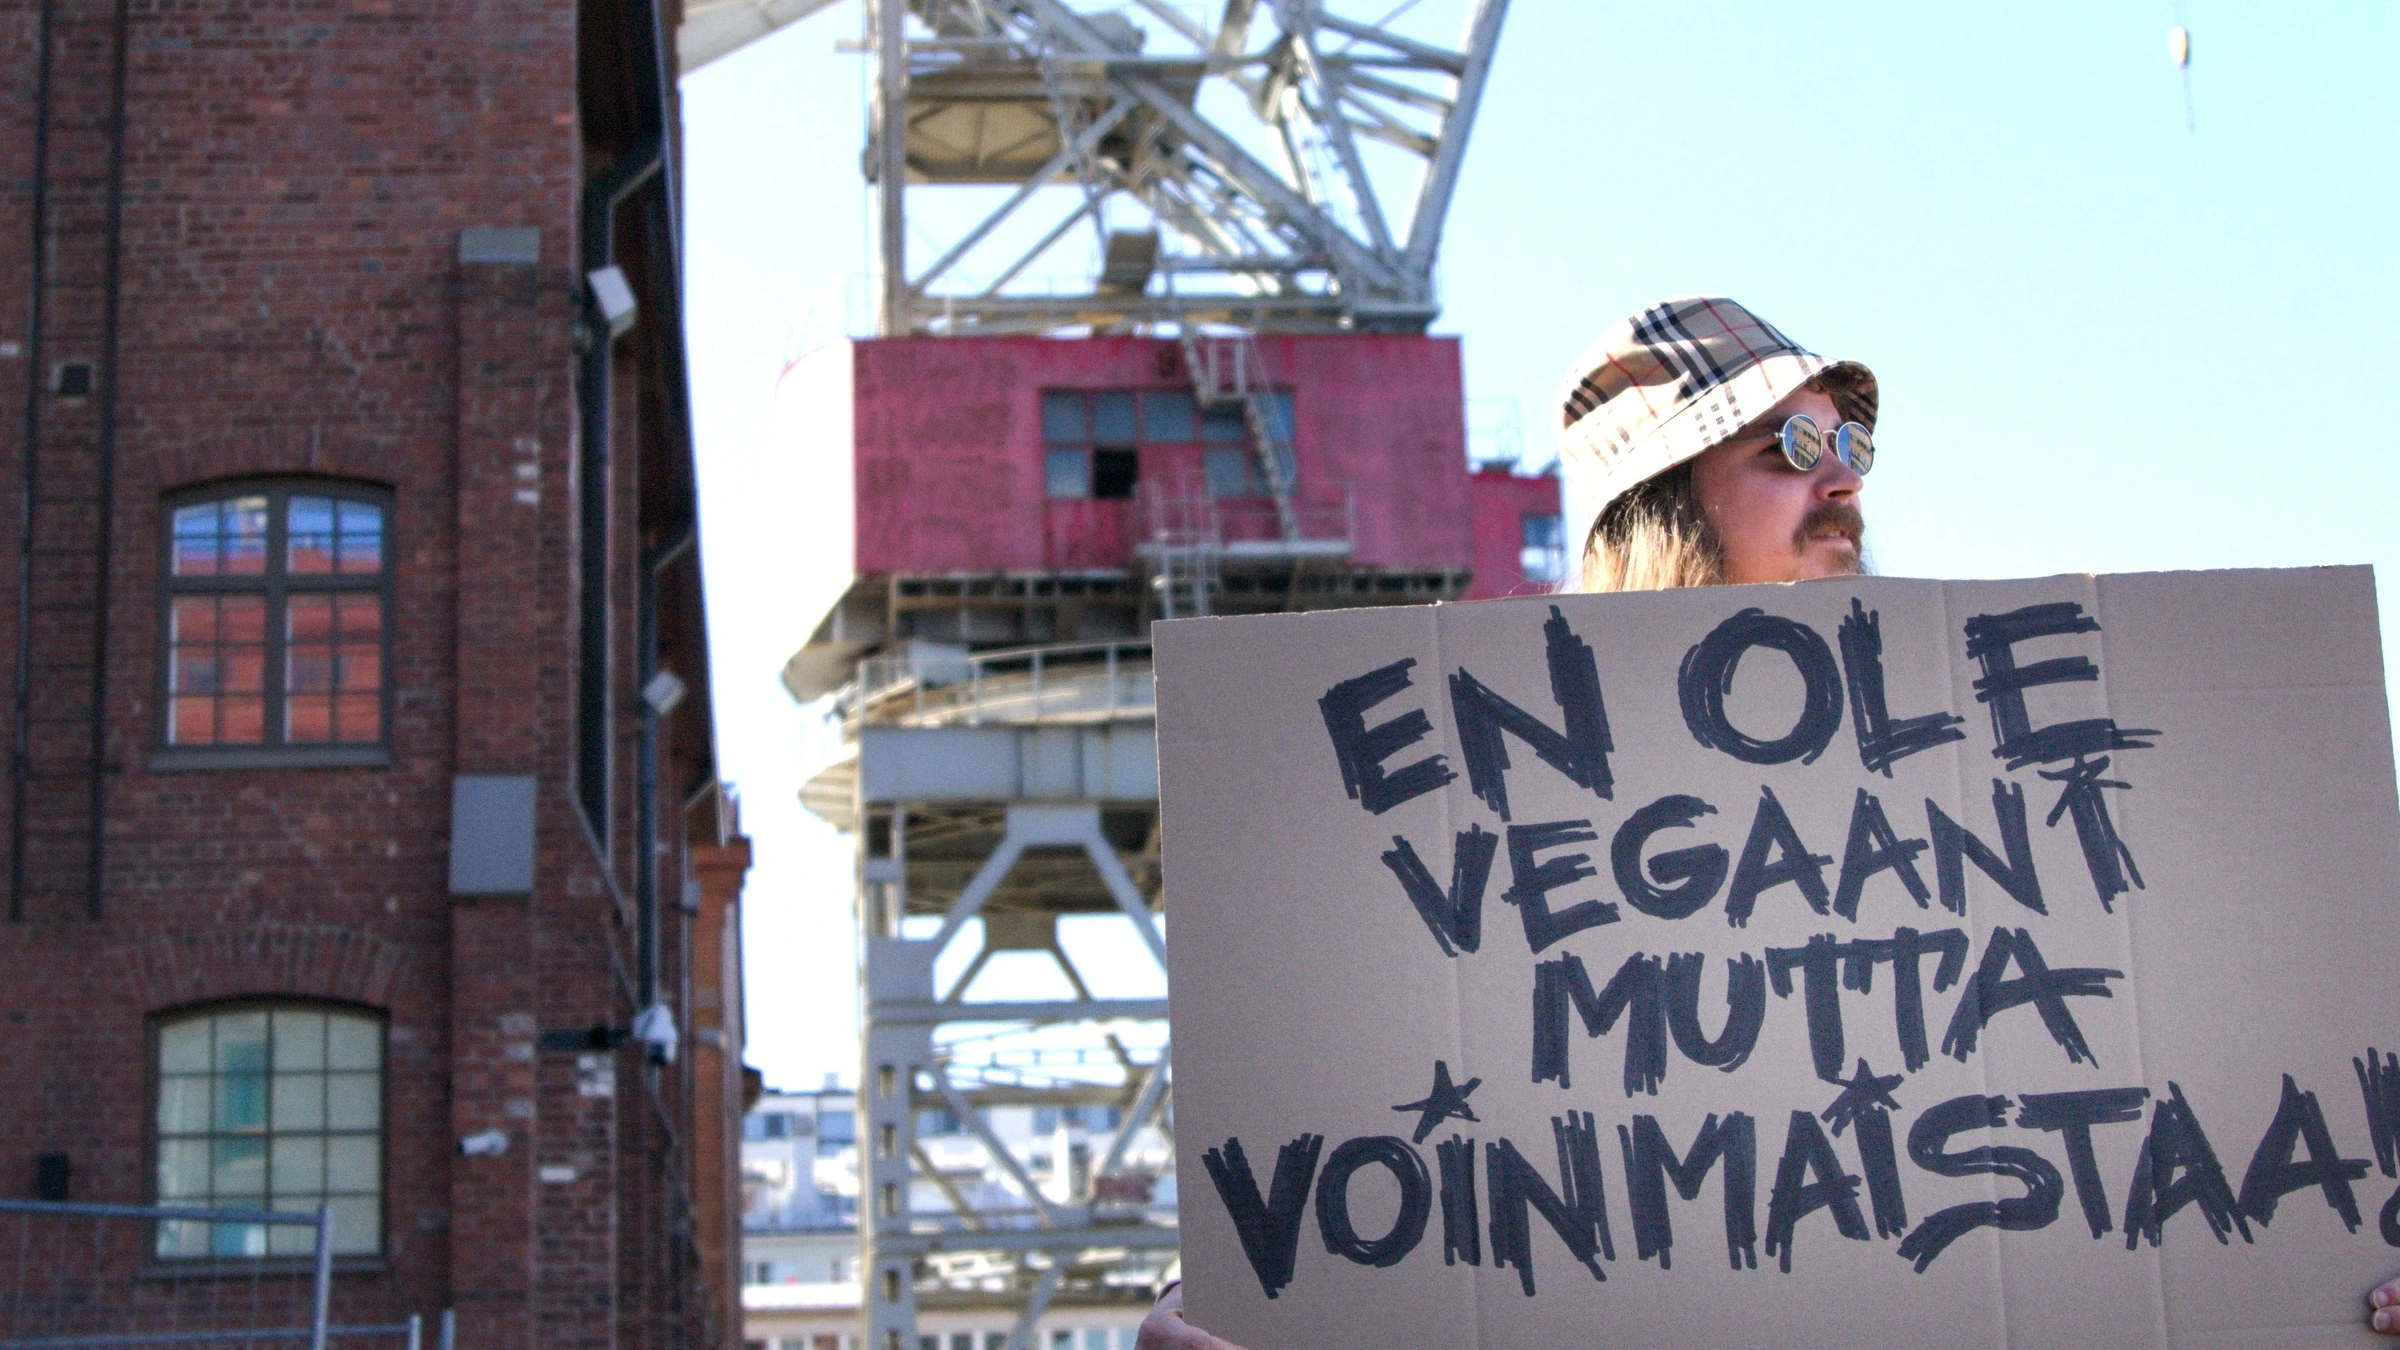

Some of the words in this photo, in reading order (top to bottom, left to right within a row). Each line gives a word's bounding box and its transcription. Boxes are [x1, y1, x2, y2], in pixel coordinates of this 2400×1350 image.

[1317, 605, 1614, 822] EN
[1678, 597, 2161, 778] OLE
[1381, 756, 2145, 957] VEGAANI
[1532, 927, 2124, 1097] MUTTA
